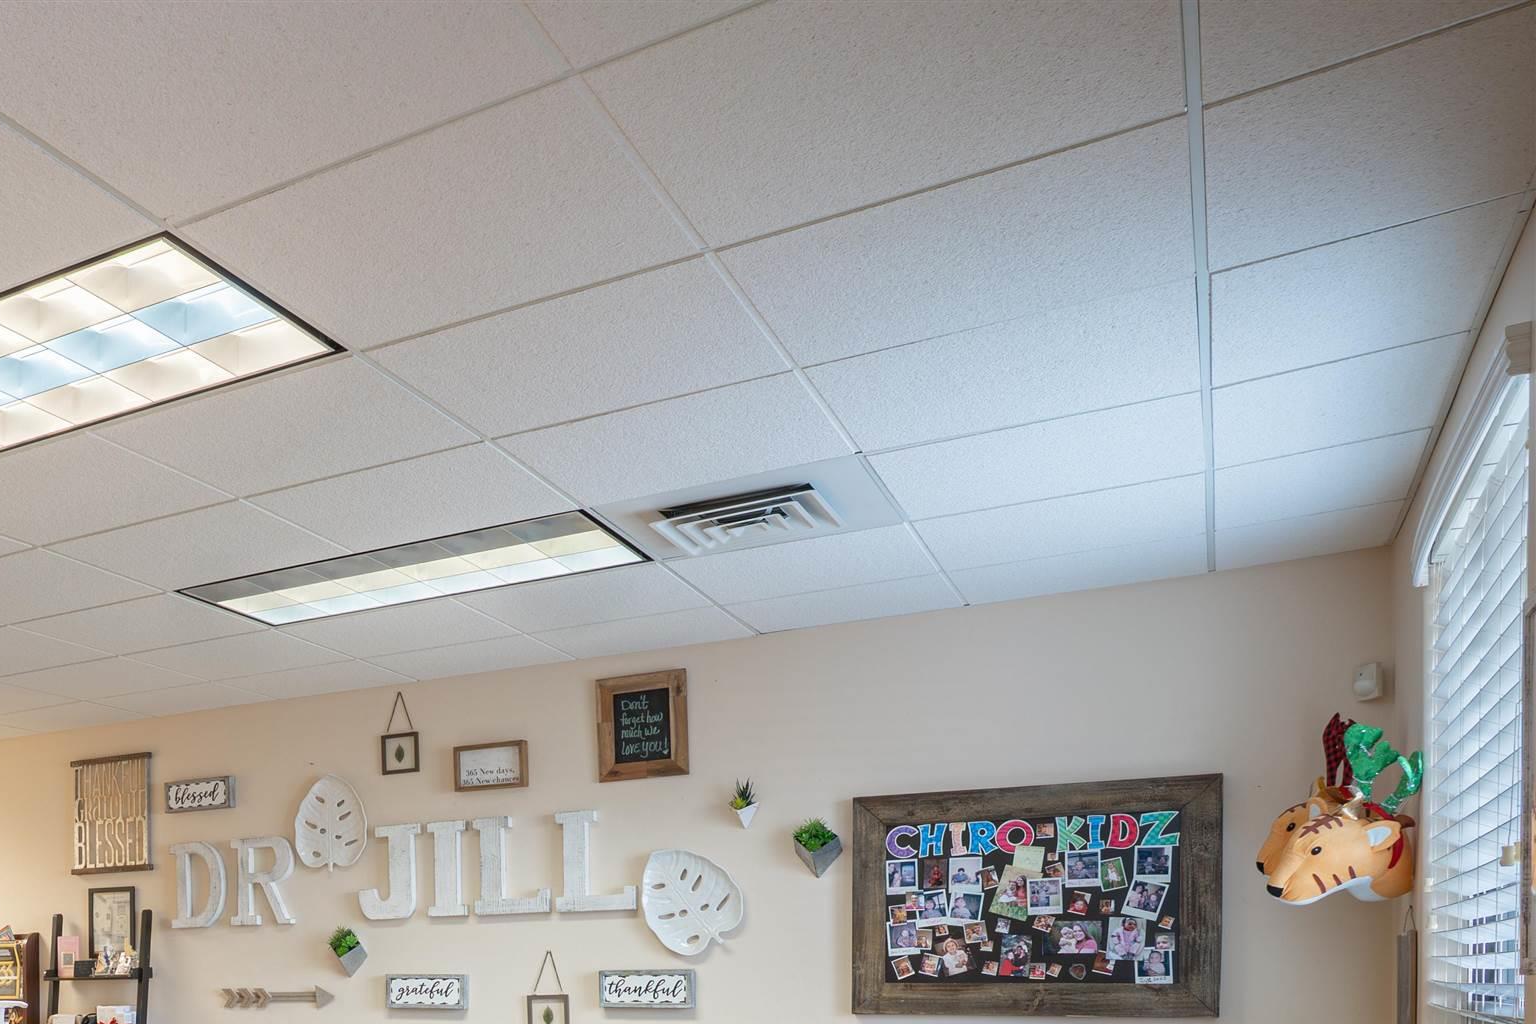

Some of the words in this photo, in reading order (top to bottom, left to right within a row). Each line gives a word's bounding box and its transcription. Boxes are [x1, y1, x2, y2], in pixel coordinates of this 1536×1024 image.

[621, 695, 648, 711] Don't
[620, 713, 645, 730] forget
[646, 712, 663, 723] how
[621, 727, 645, 739] much
[175, 783, 218, 804] blessed
[75, 816, 147, 869] BLESSED
[885, 819, 1034, 858] CHIRO
[1055, 811, 1180, 852] KIDZ
[169, 836, 297, 929] DR
[359, 810, 637, 920] JILL
[397, 981, 453, 1001] grateful
[608, 979, 685, 998] thankful
